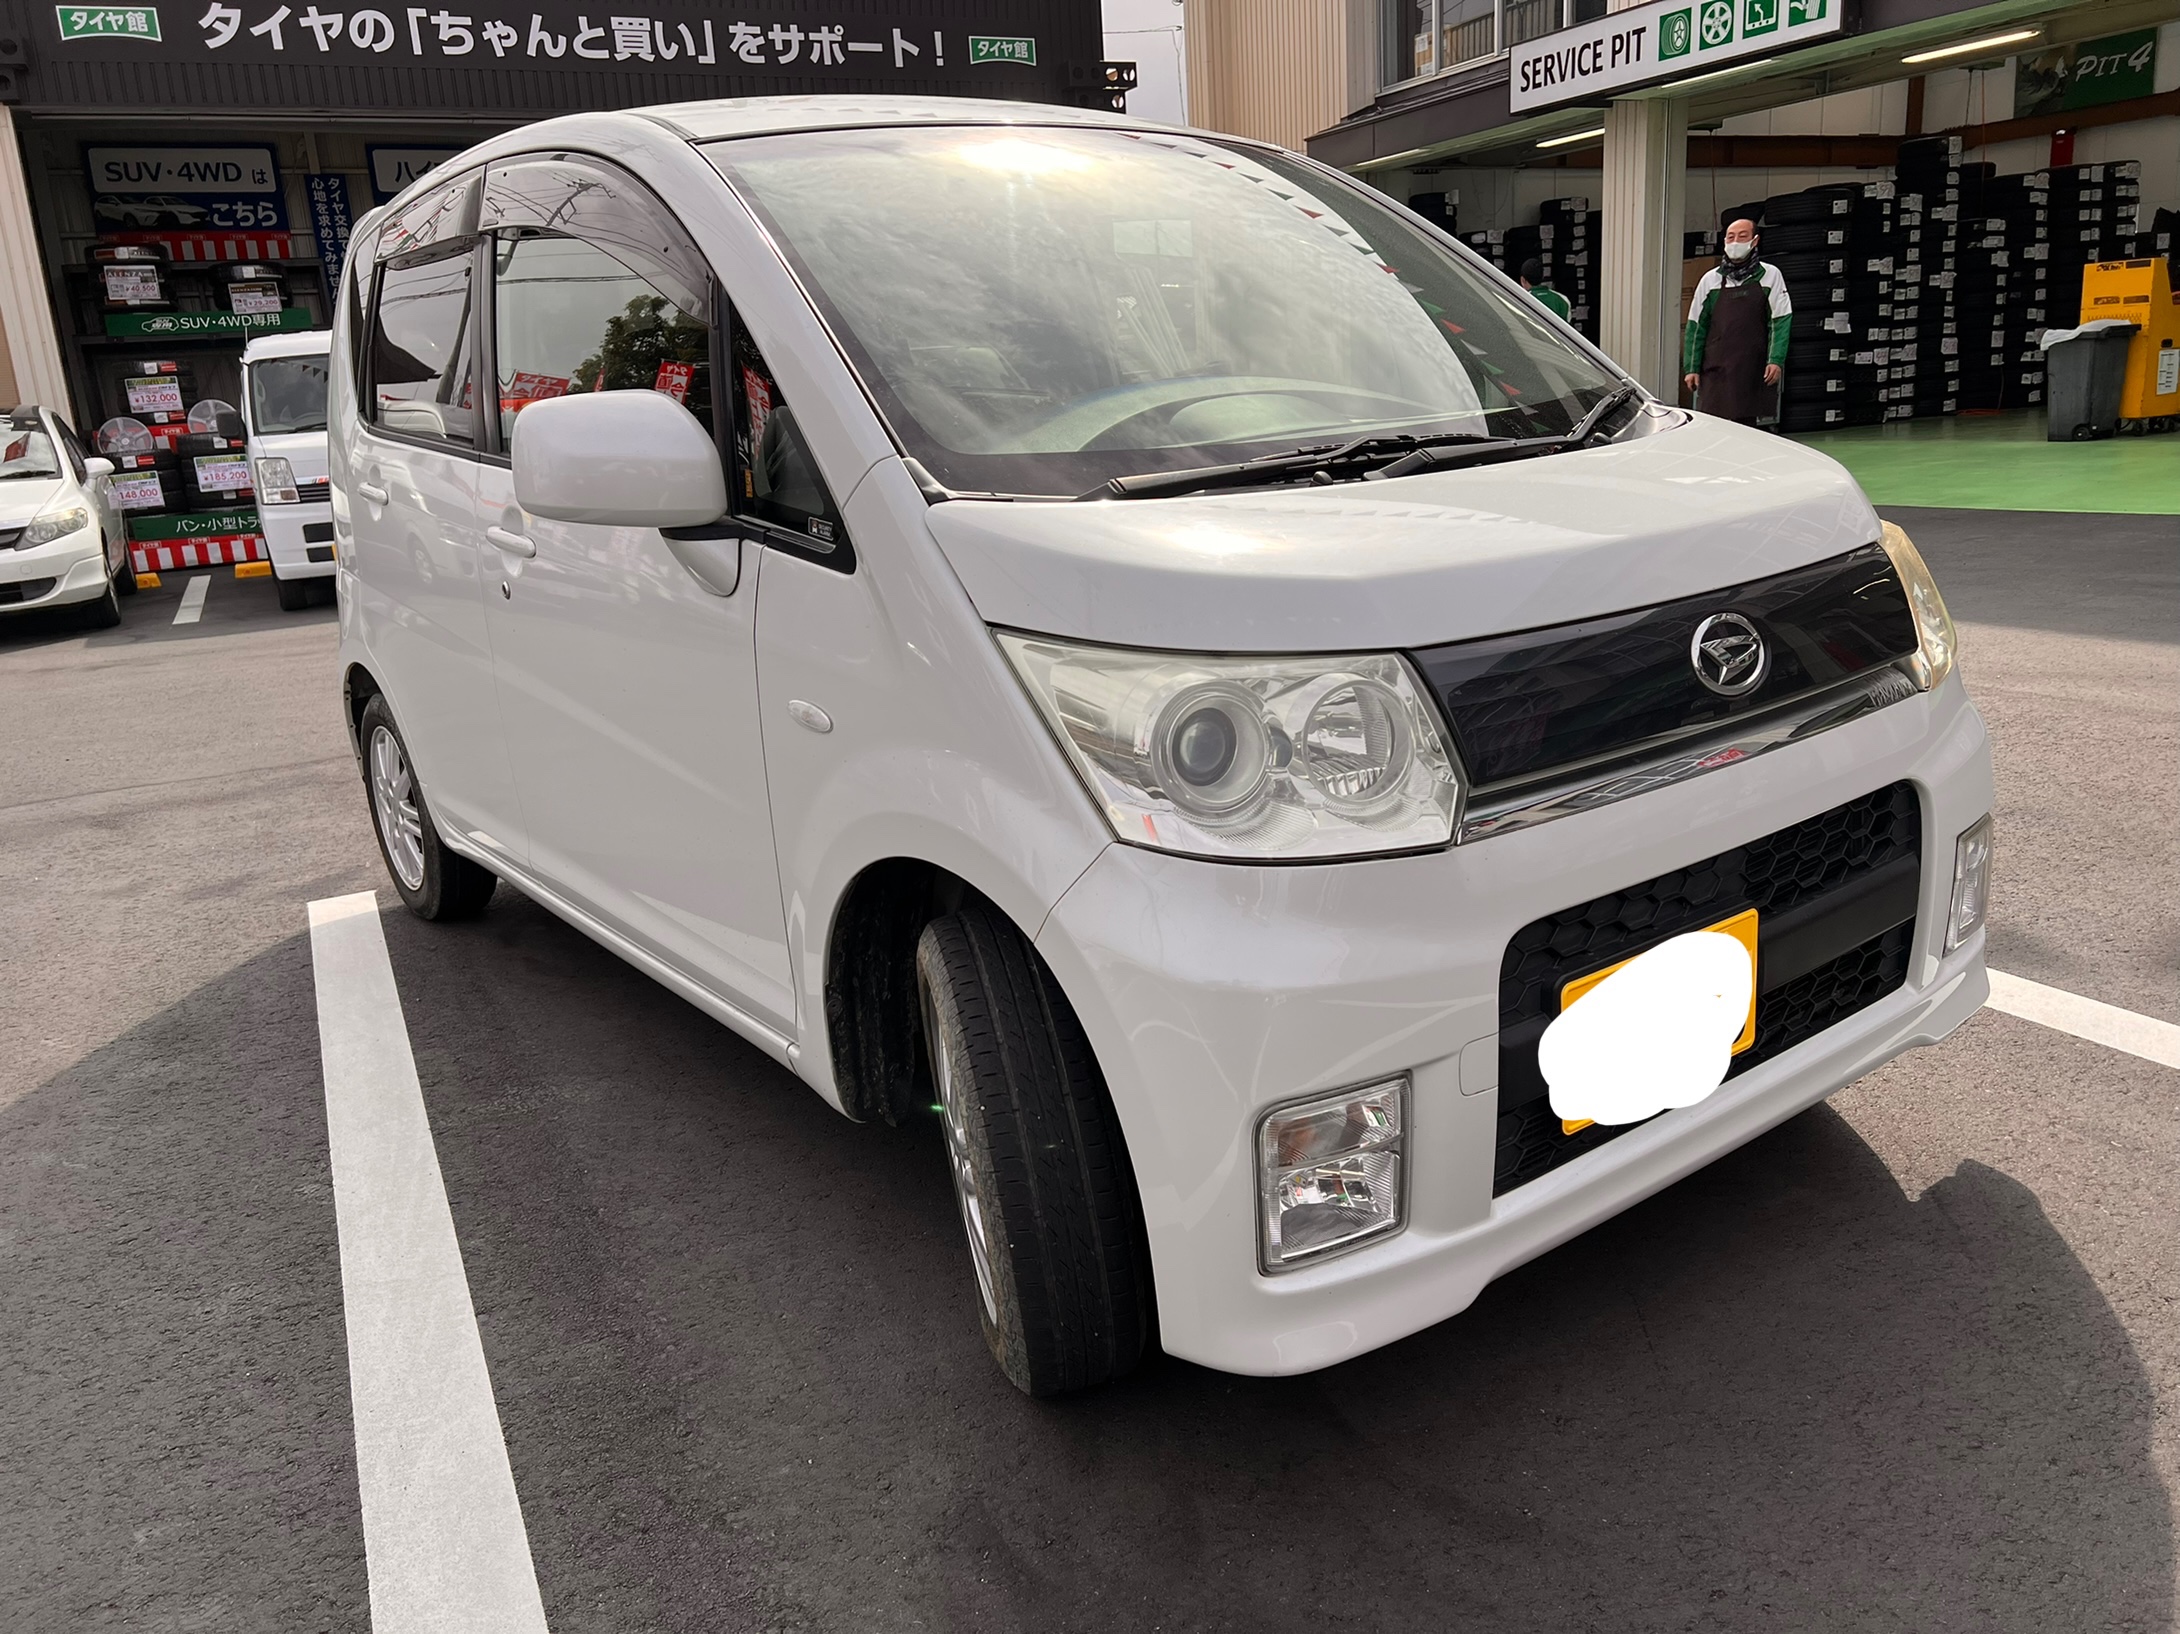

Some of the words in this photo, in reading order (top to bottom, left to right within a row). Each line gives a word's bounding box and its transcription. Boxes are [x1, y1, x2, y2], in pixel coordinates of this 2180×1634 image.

[70, 11, 148, 32] タイヤ館
[977, 40, 1028, 58] タイヤ館
[1519, 39, 1604, 93] SERVICE
[1610, 26, 1647, 69] PIT
[2075, 53, 2127, 82] PIT
[2127, 41, 2153, 73] 4
[212, 201, 278, 226] こちら
